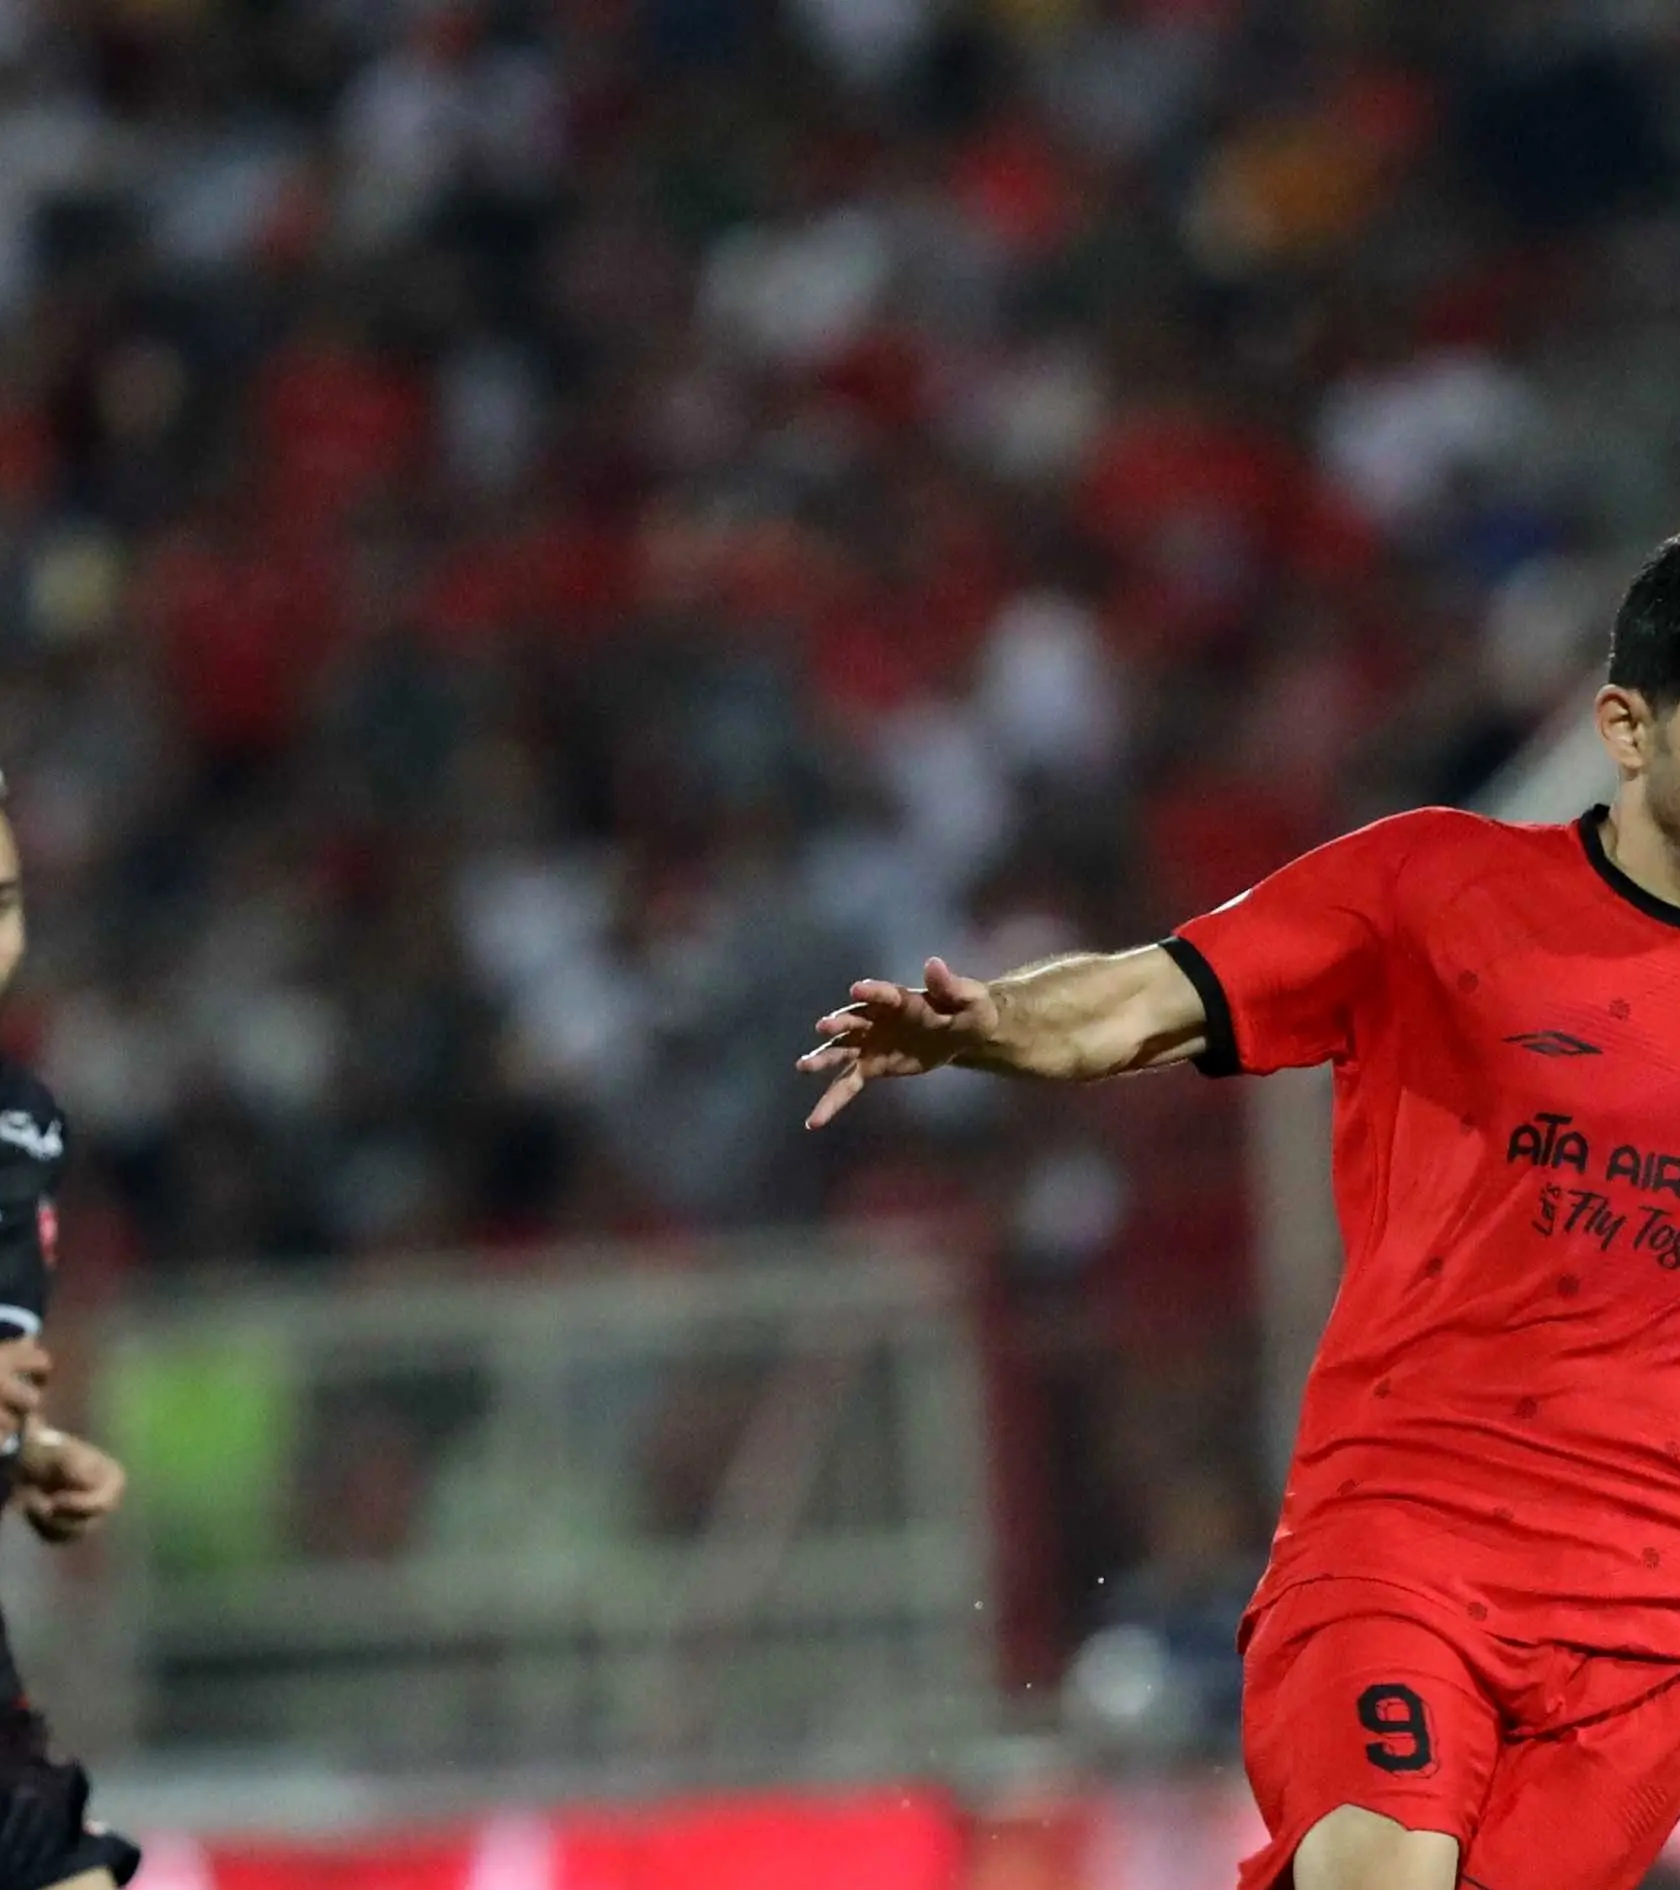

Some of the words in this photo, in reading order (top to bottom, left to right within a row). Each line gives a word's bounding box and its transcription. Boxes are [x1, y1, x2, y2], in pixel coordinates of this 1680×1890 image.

[1506, 1112, 1590, 1174] ATA
[1564, 1188, 1626, 1251] Fly
[1356, 1683, 1433, 1772] 9
